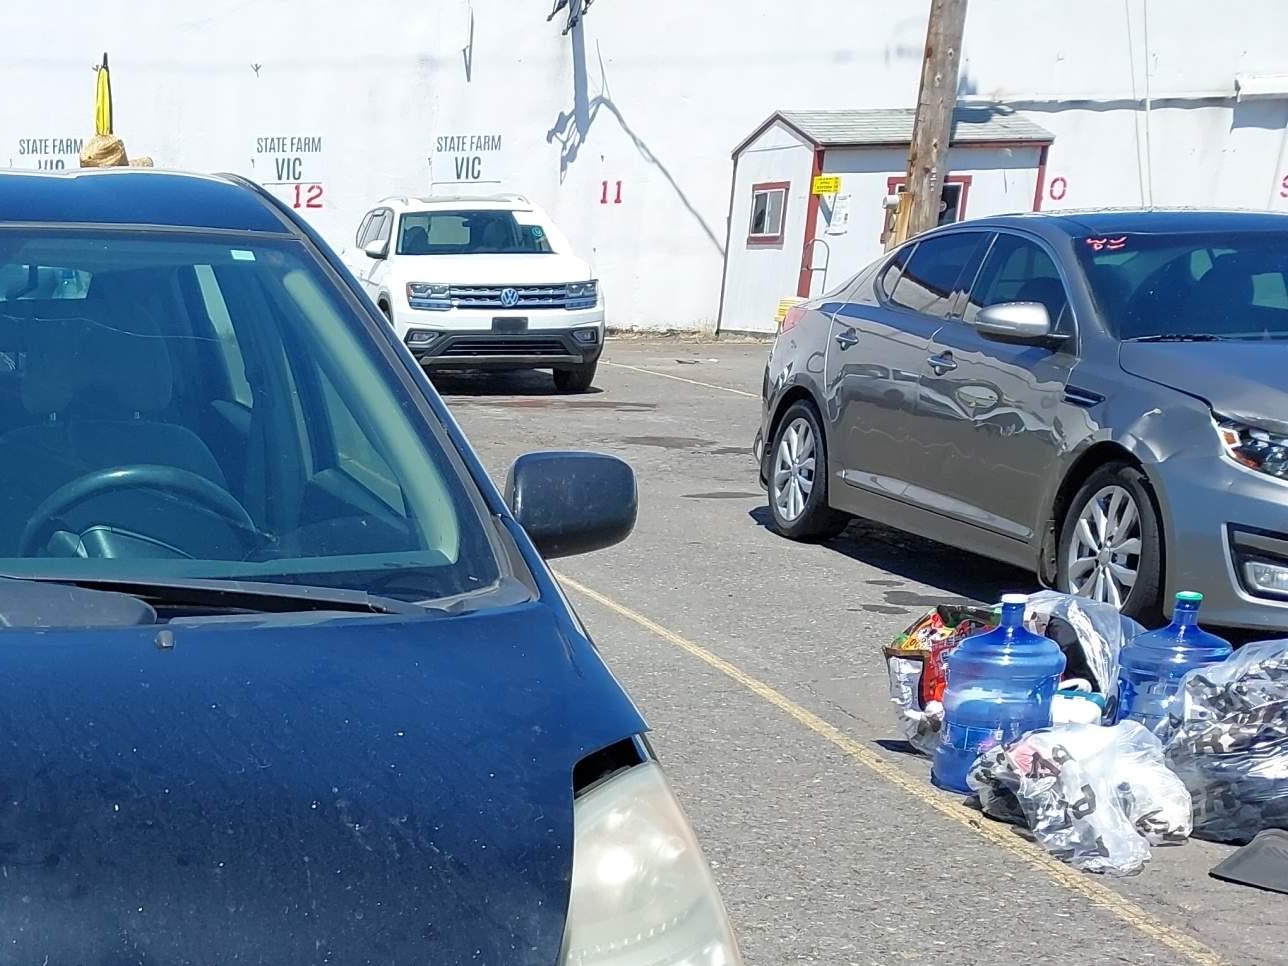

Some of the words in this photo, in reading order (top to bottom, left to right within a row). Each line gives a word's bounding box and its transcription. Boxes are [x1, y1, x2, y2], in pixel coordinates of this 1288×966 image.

[18, 137, 49, 156] STATE
[52, 137, 83, 156] FARM
[256, 136, 287, 154] STATE
[290, 135, 322, 153] FARM
[436, 134, 467, 153] STATE
[469, 134, 502, 152] FARM
[275, 157, 302, 181] VIC
[454, 156, 482, 180] VIC
[293, 184, 323, 209] 12
[599, 181, 623, 205] 11
